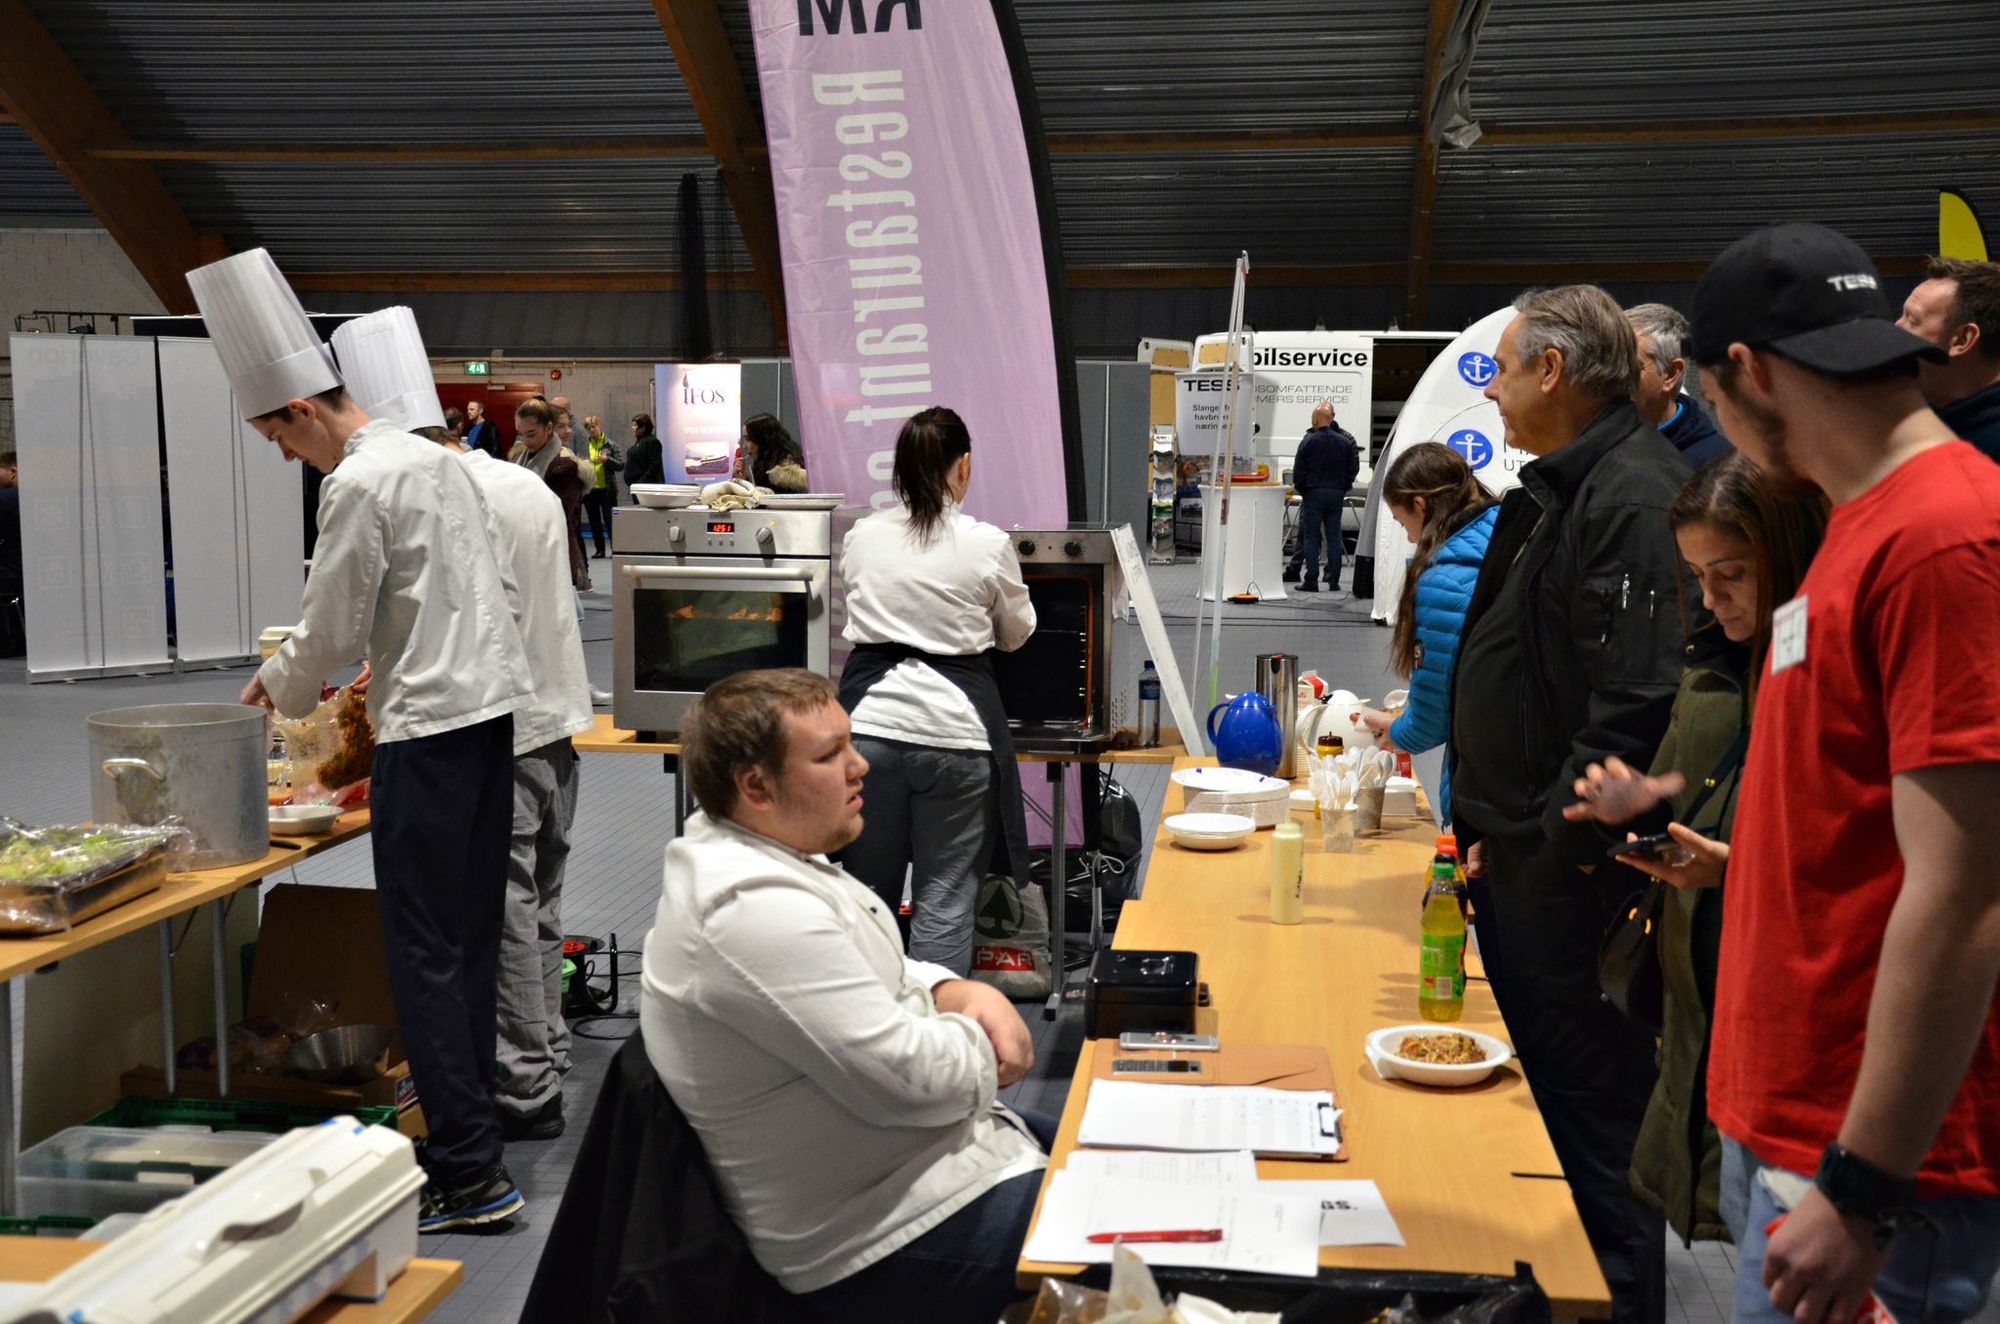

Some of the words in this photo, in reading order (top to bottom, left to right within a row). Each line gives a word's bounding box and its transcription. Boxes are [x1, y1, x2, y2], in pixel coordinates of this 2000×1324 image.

[1183, 379, 1240, 392] TESS
[1254, 384, 1353, 394] SOMFATTENDE
[1296, 396, 1350, 404] SERVICE
[976, 949, 1033, 967] PAR
